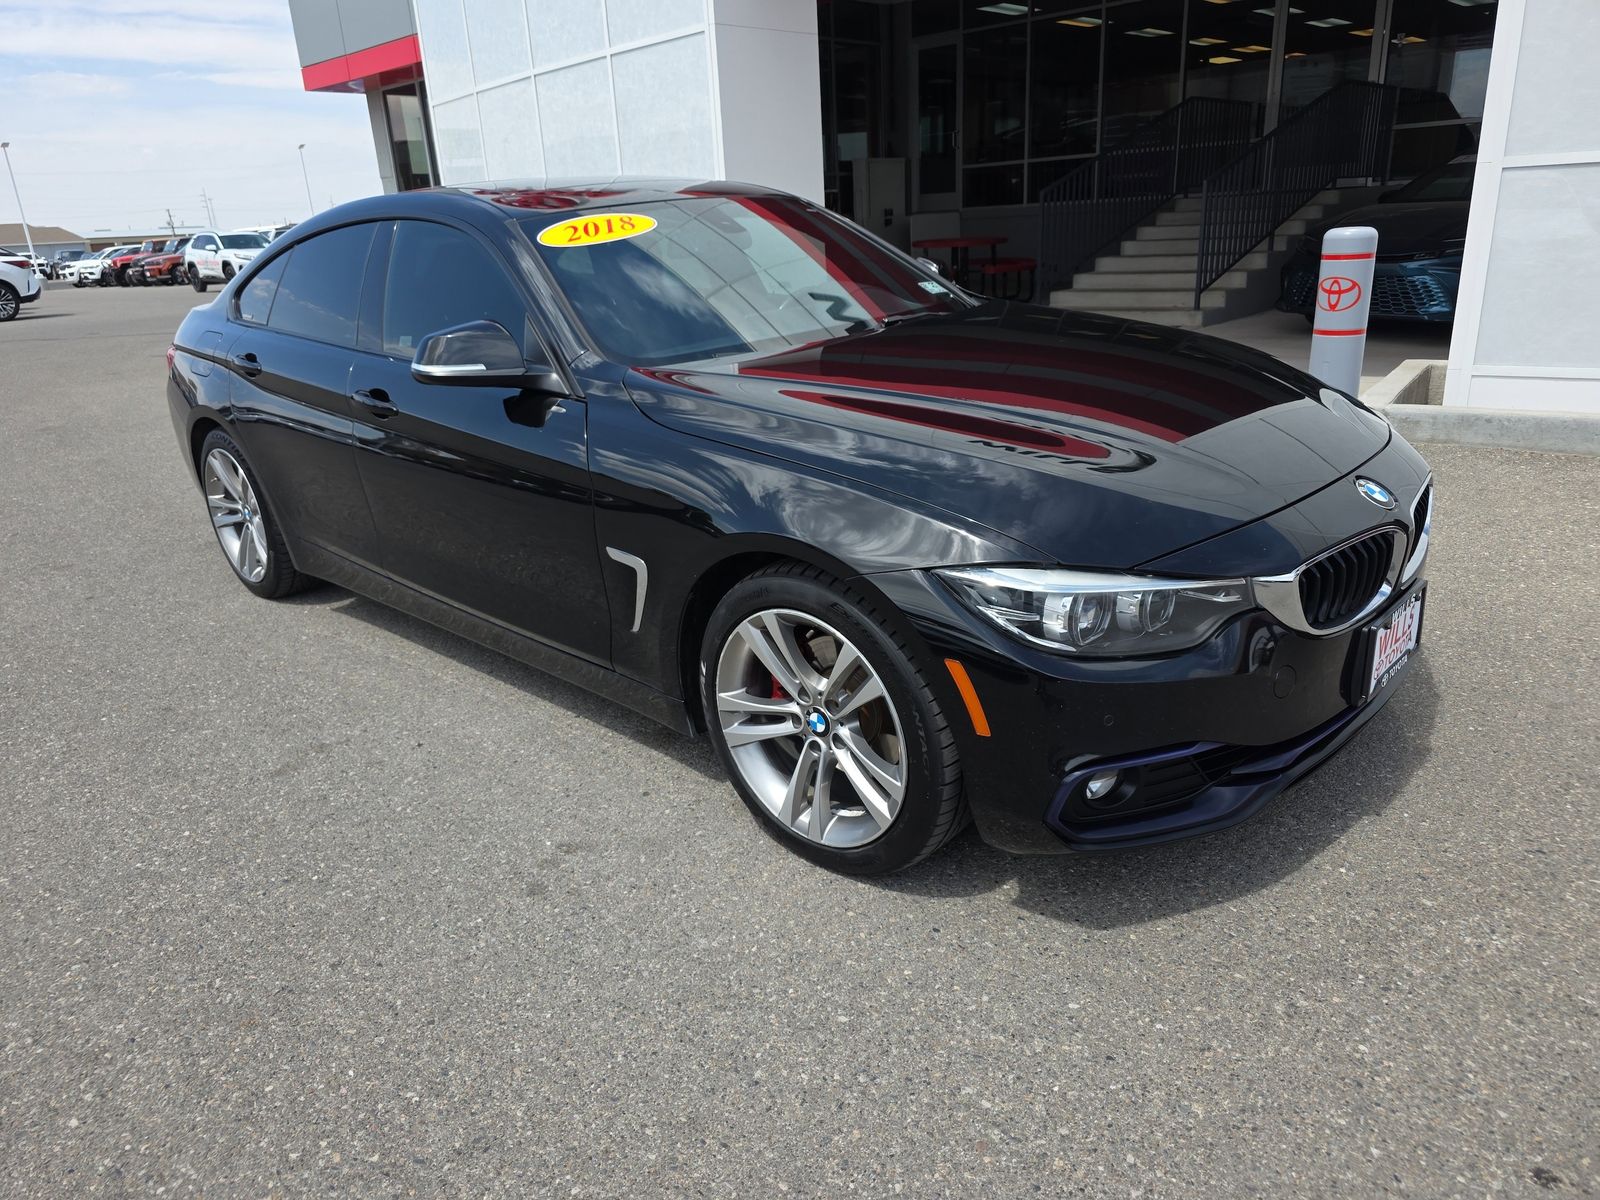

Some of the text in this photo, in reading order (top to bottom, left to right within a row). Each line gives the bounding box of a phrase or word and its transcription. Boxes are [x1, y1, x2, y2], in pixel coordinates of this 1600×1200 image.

[564, 216, 636, 242] 2018
[1379, 605, 1414, 658] WILLS
[1384, 630, 1412, 669] TOYOTA
[1389, 654, 1408, 679] TOYOTA
